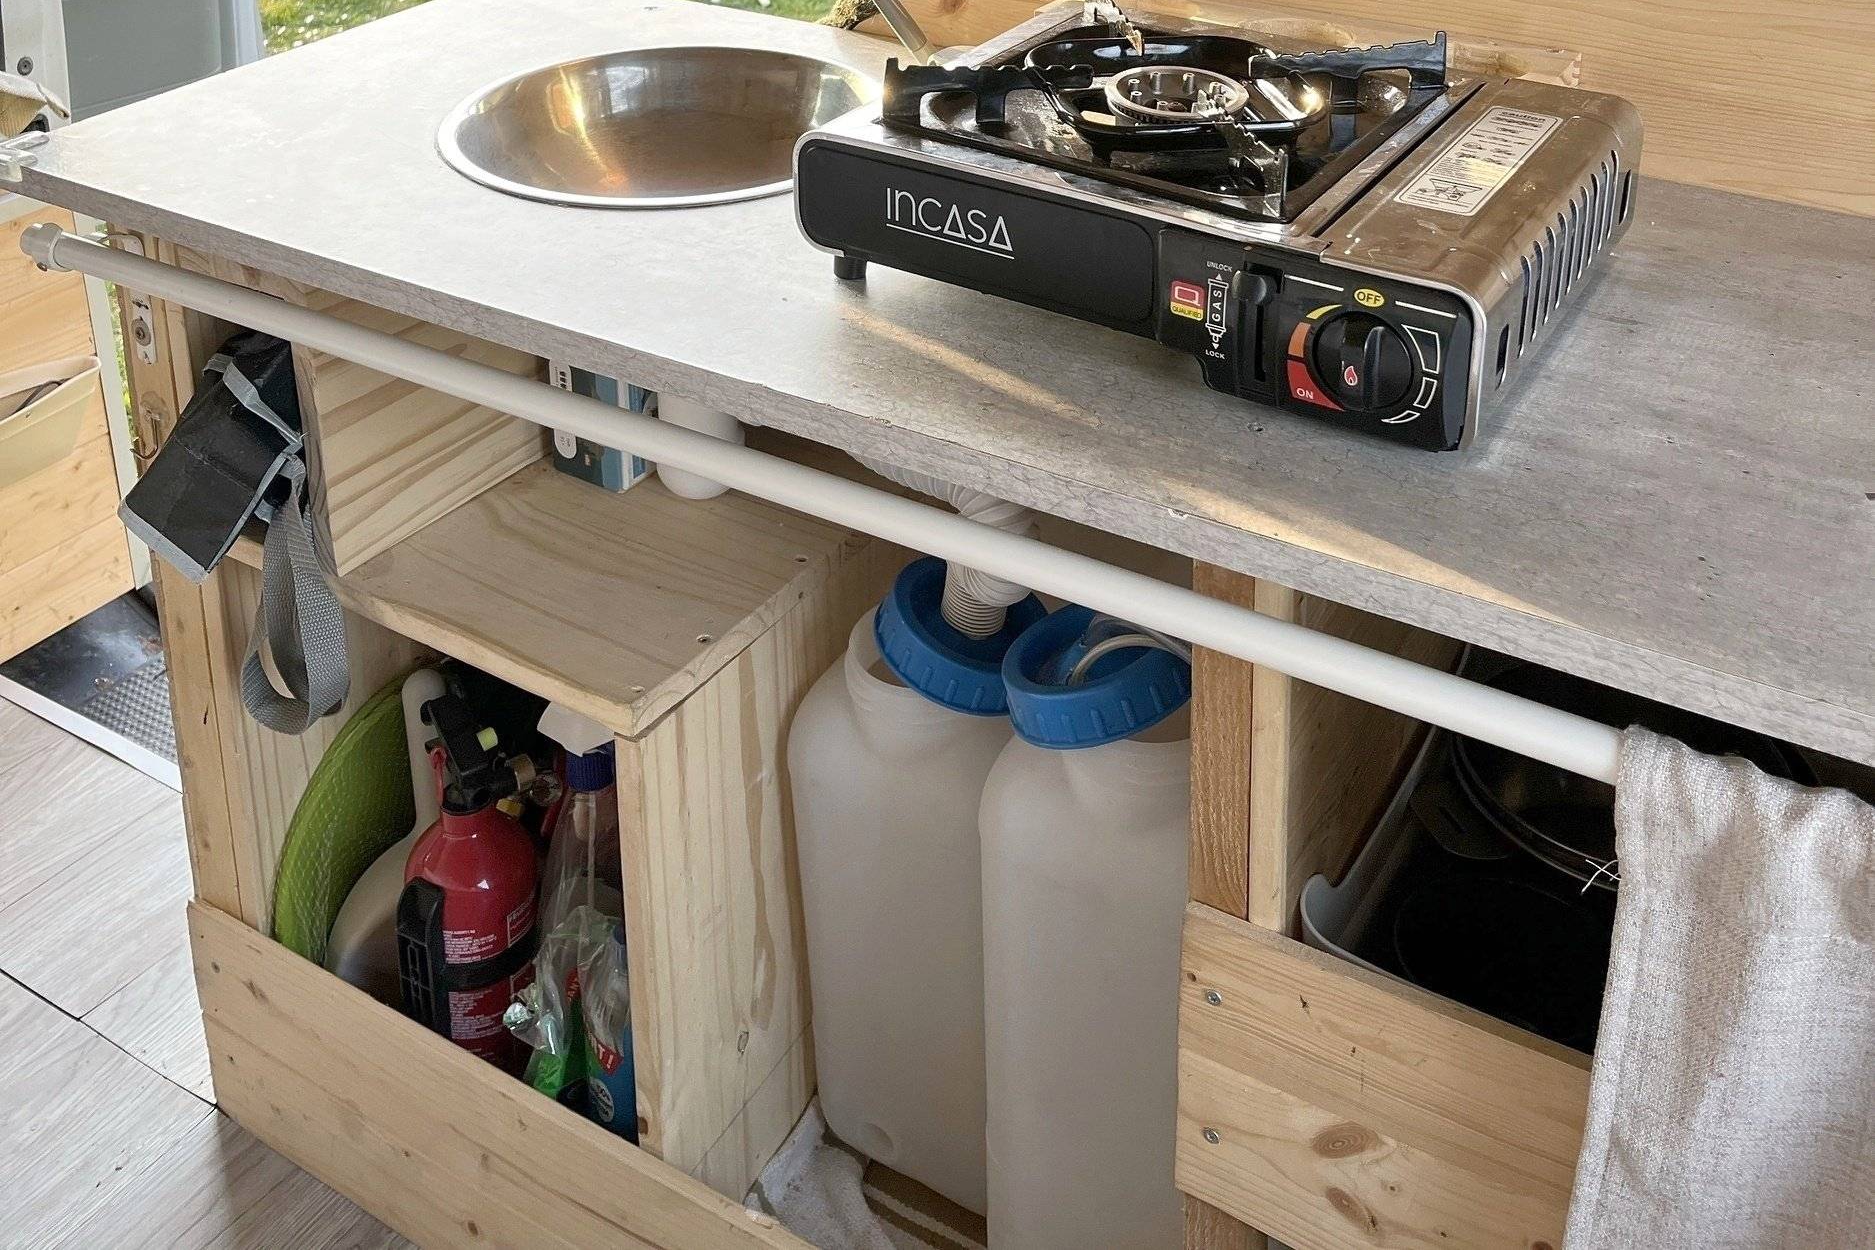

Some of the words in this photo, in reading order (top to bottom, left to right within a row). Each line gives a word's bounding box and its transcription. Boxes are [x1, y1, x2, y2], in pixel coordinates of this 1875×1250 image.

[1206, 260, 1233, 273] UNLOCK
[1356, 291, 1381, 304] OFF
[1171, 304, 1202, 319] QUALIFIED
[1211, 289, 1223, 322] GAS
[1205, 349, 1226, 360] LOCK
[1295, 386, 1314, 400] ON
